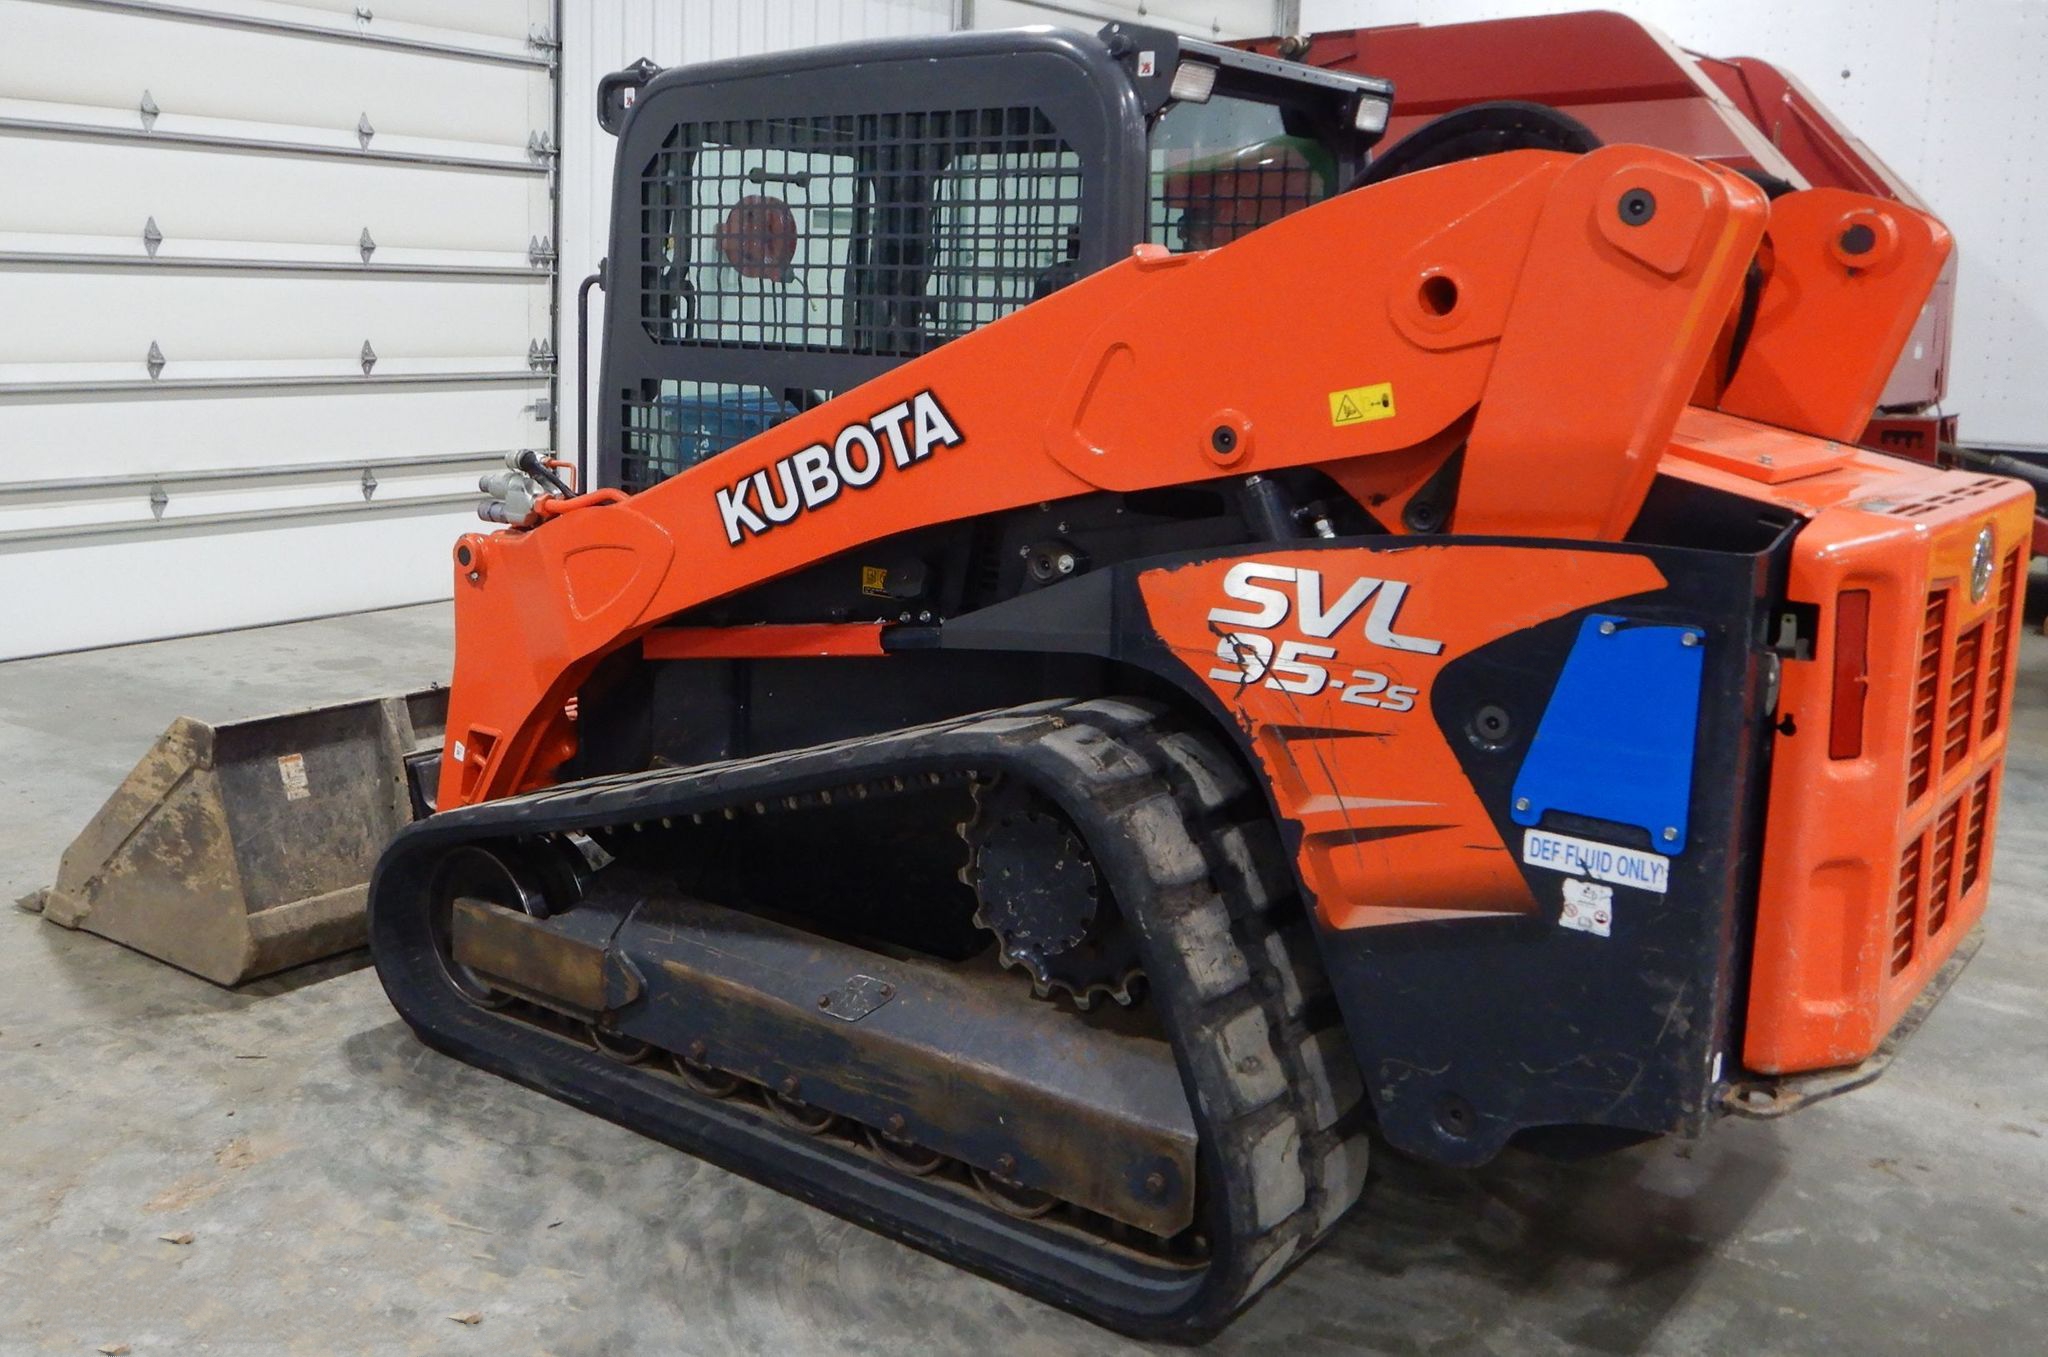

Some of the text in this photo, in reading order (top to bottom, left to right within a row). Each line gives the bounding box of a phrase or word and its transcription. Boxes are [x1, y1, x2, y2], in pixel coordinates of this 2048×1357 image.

[715, 389, 962, 545] KUBOTA
[1208, 562, 1443, 655] SVL
[1530, 837, 1660, 884] DEF FLUID ONLY
